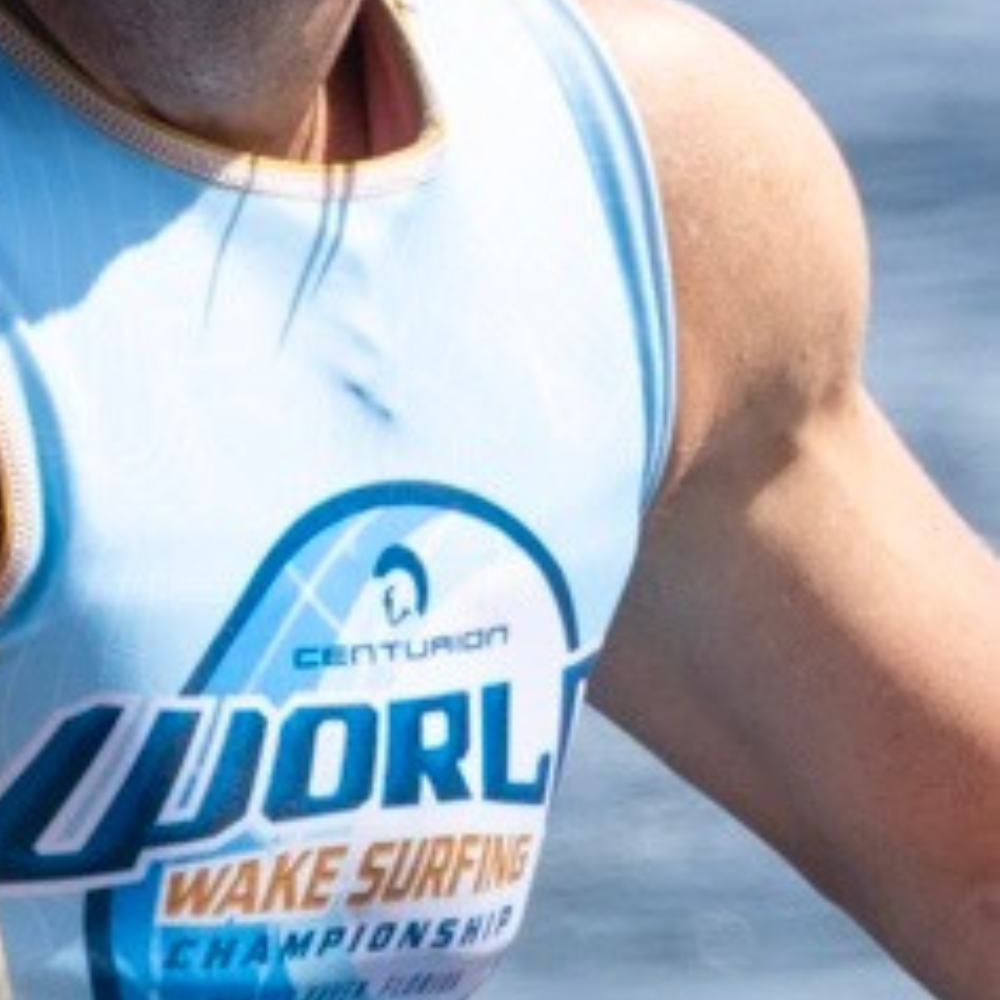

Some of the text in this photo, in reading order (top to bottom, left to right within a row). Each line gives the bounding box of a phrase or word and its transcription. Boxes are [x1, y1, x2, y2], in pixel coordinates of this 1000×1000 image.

[293, 624, 509, 669] CENTURION
[164, 833, 534, 918] WAKE SURFING
[163, 905, 513, 969] CHAMPIONSHIP
